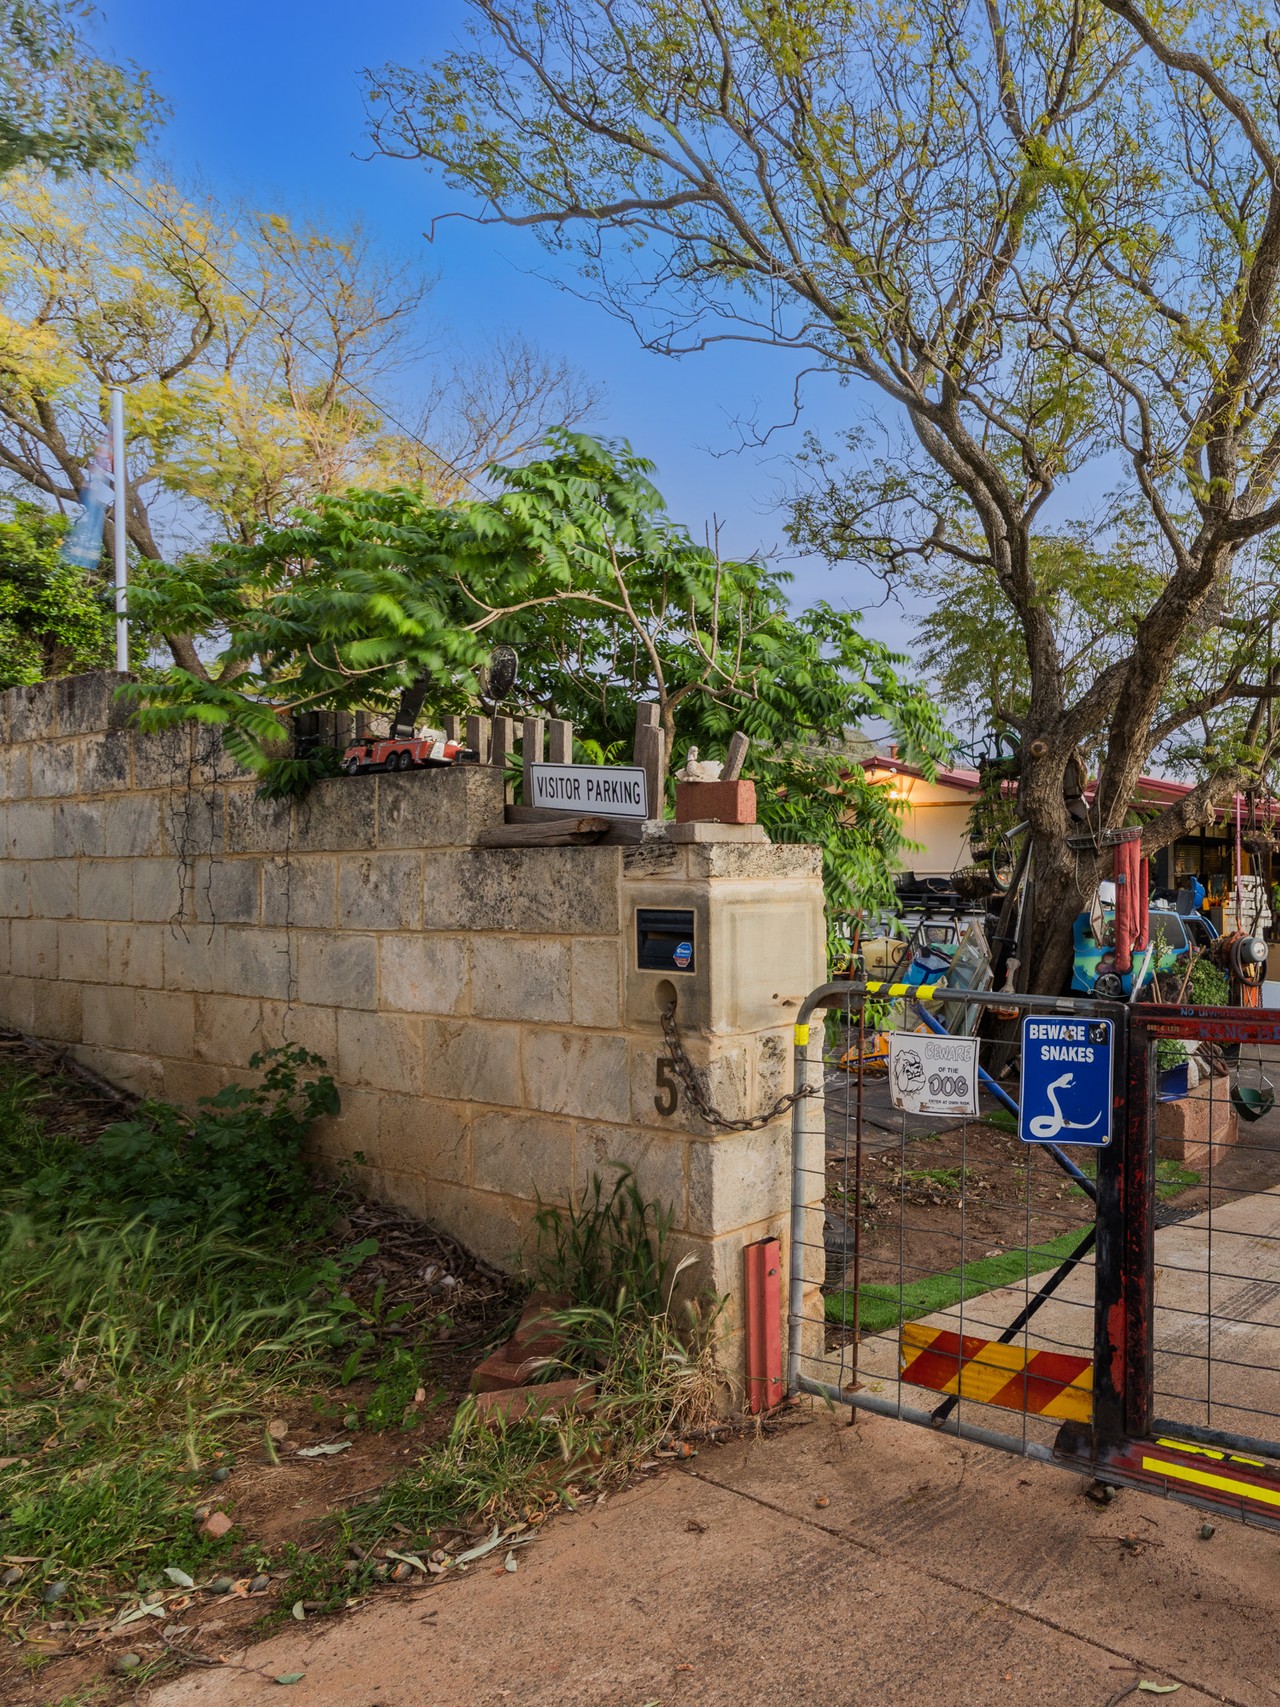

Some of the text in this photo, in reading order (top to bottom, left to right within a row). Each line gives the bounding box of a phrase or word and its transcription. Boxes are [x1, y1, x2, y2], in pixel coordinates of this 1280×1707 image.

[537, 776, 641, 805] VISITOR PARKING
[1181, 1007, 1194, 1016] NO
[1029, 1024, 1086, 1041] BEWARE
[925, 1041, 972, 1062] BEWARE
[1041, 1045, 1094, 1063] SNAKES
[654, 1057, 678, 1116] 5
[928, 1073, 969, 1097] DOG
